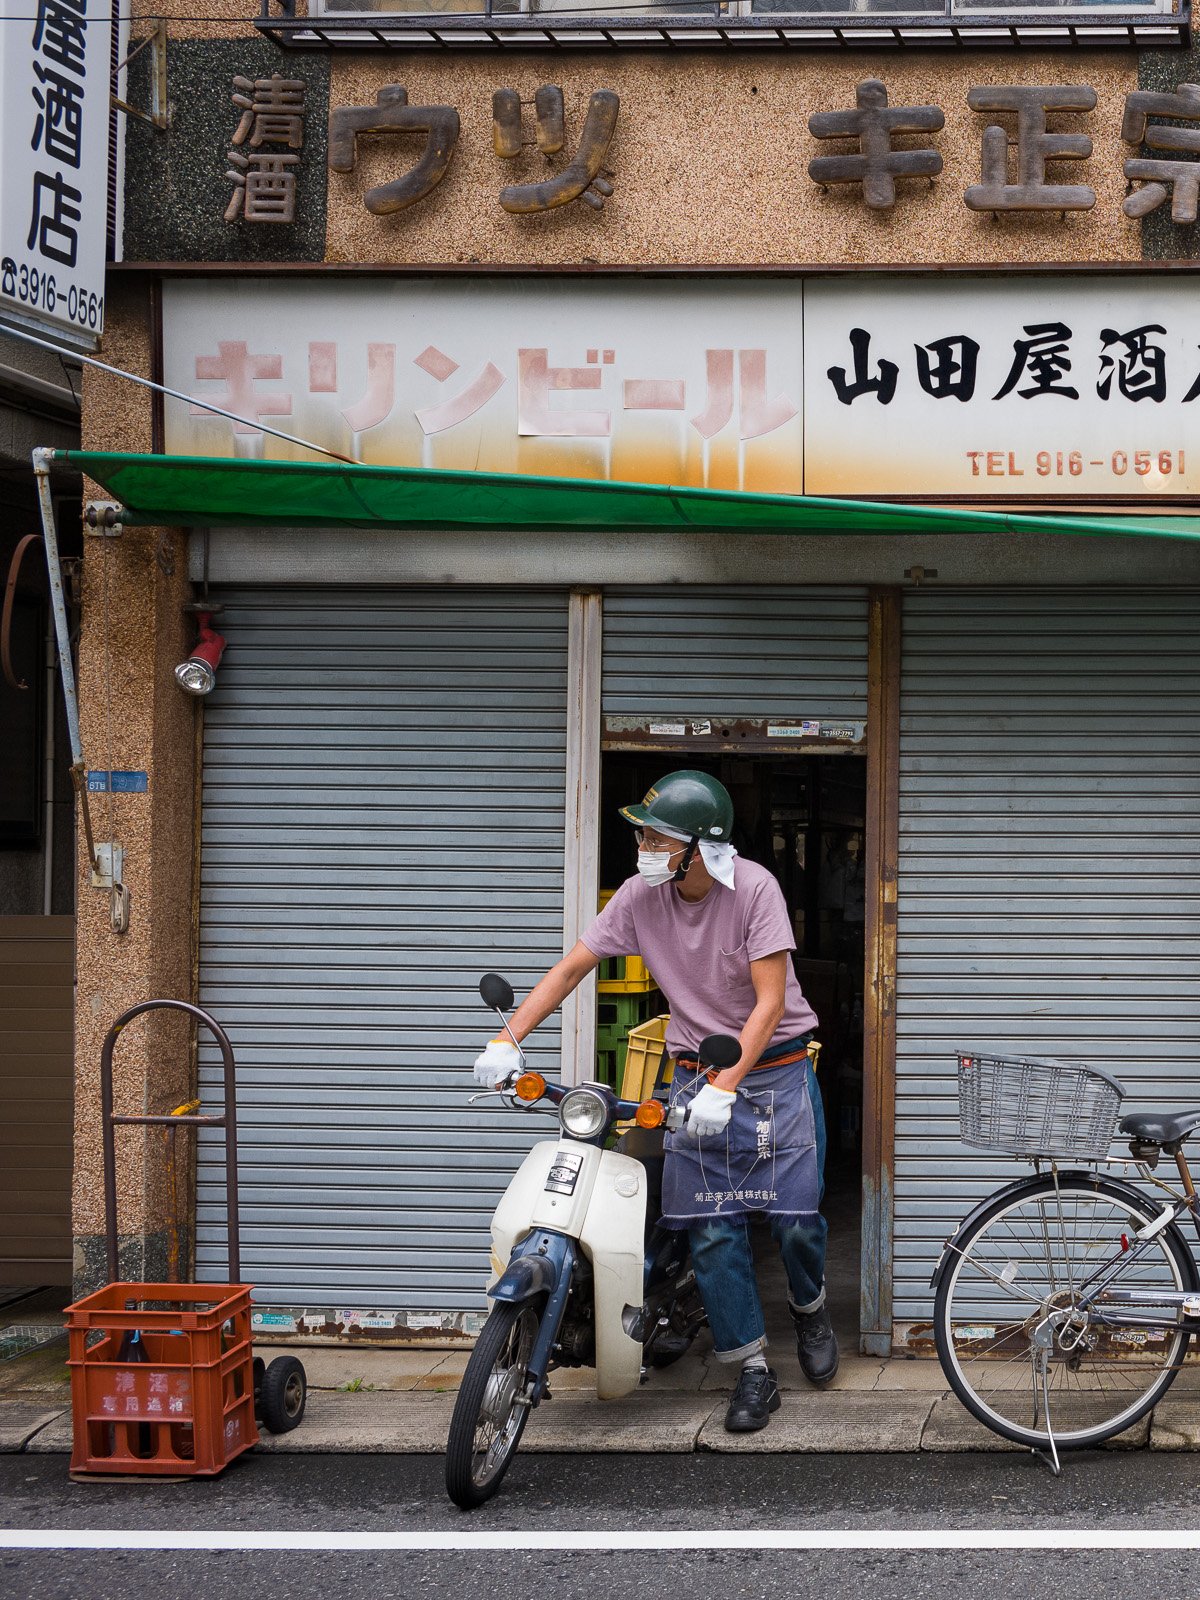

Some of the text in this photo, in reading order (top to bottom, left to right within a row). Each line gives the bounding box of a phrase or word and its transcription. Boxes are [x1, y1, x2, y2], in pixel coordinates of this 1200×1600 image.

[226, 74, 306, 222] 清酒
[18, 263, 104, 332] 3916-0561
[189, 341, 800, 440] キリンビール
[966, 450, 1185, 476] TEL 916-0561
[756, 1120, 771, 1159] 菊正宗
